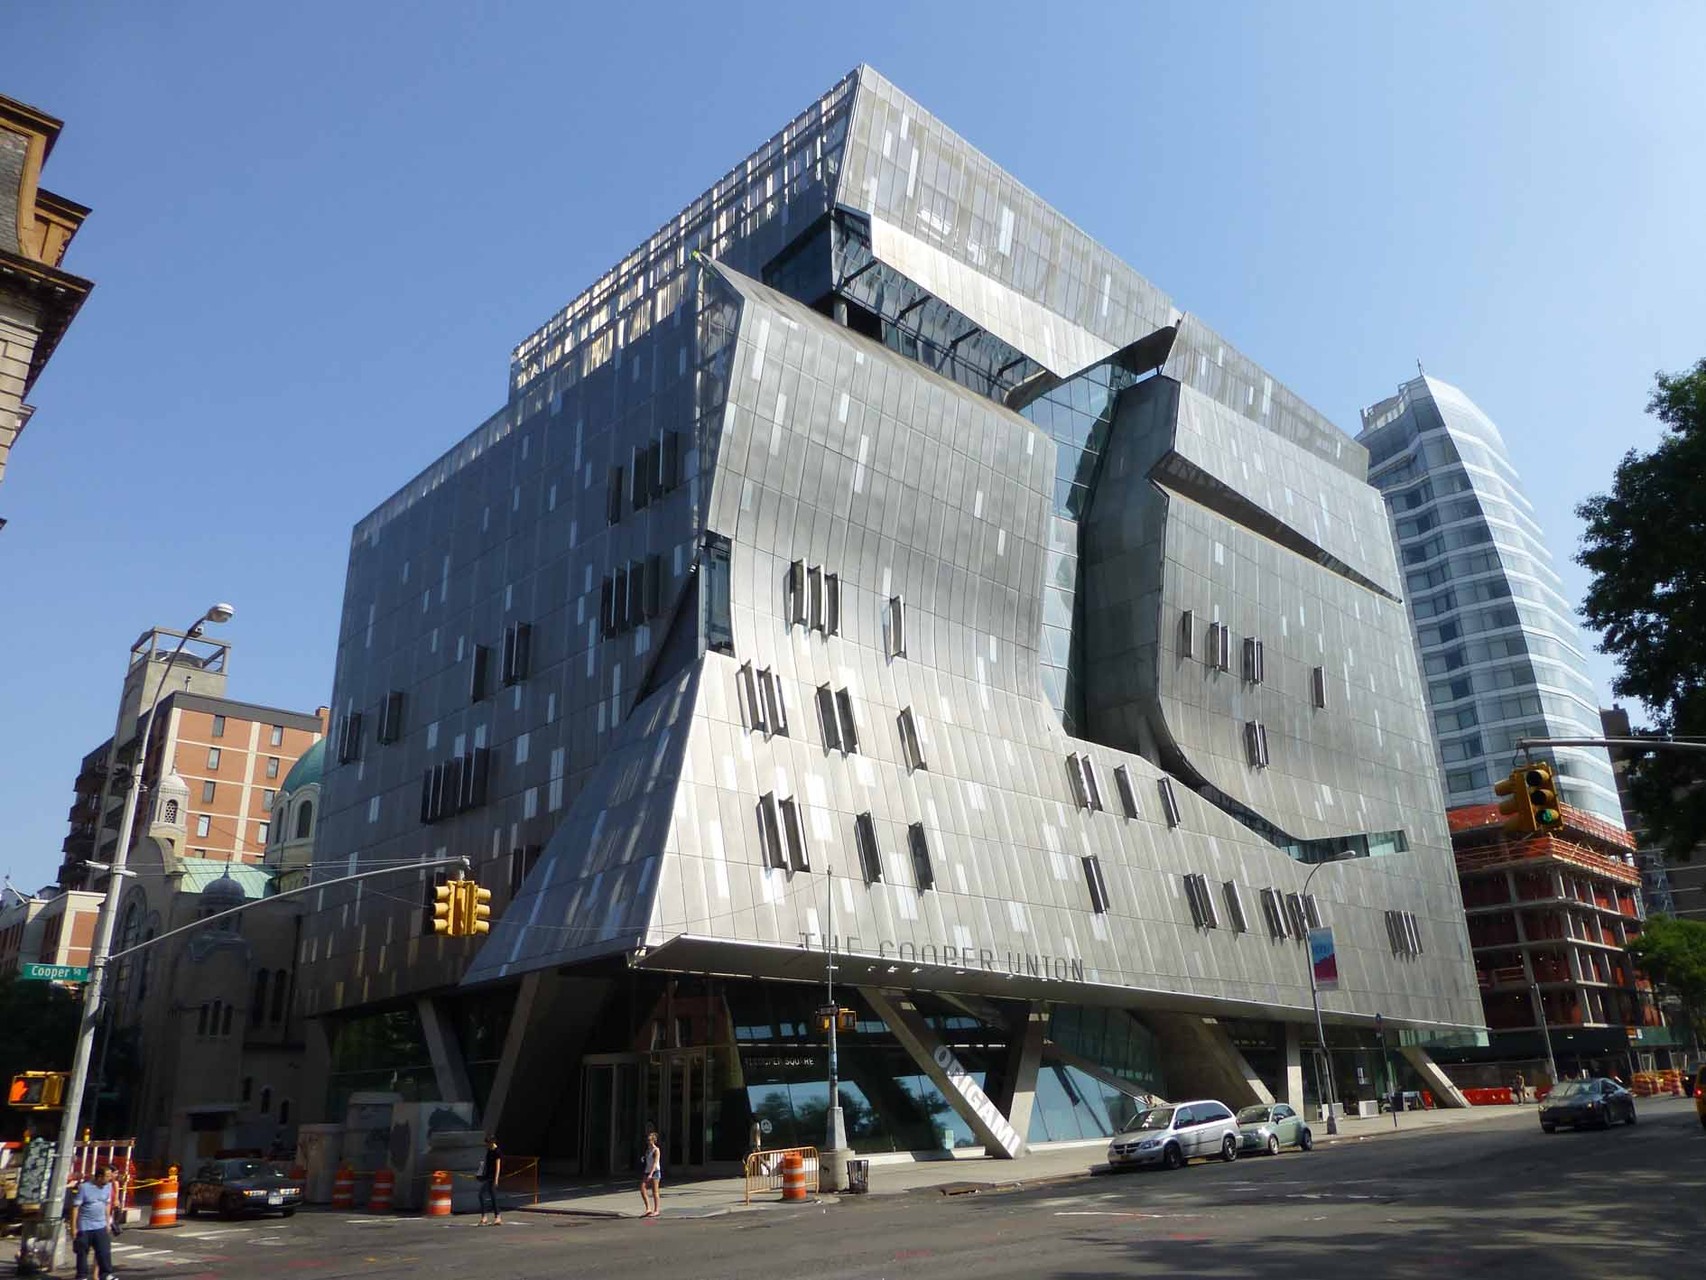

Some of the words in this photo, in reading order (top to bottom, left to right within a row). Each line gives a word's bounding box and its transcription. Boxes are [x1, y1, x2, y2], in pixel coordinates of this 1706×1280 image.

[31, 966, 70, 979] Cooper
[799, 932, 862, 954] THE
[879, 940, 993, 971] COOPER
[1007, 951, 1085, 983] UNION
[785, 1056, 815, 1066] SQURE
[934, 1045, 1021, 1158] ORIGAMI
